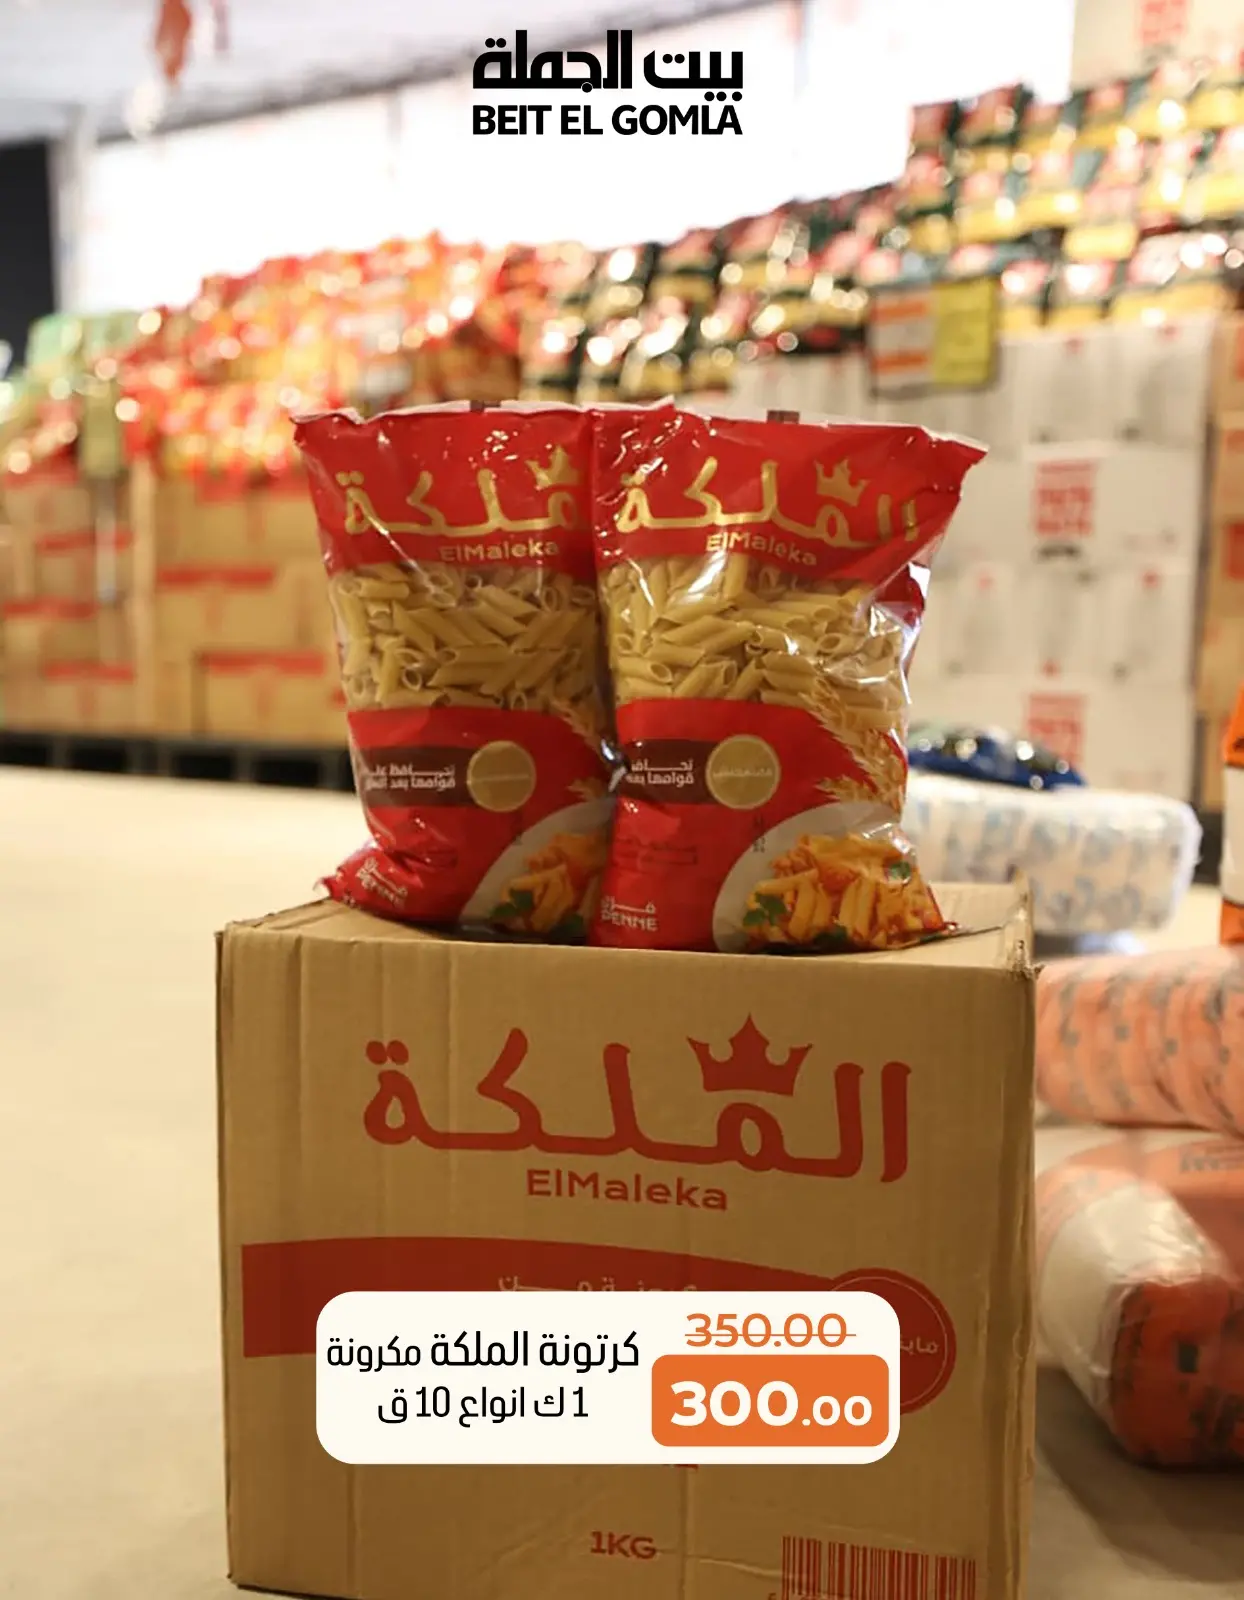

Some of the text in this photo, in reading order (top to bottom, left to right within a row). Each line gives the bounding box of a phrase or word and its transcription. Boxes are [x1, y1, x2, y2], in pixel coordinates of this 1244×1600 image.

[616, 456, 918, 548] الملكة
[440, 537, 560, 562] ElMaleka
[706, 531, 817, 566] ElMaleka
[364, 1028, 911, 1183] الملكة
[526, 1169, 728, 1211] ElMaleka
[590, 1530, 657, 1560] 1KG
